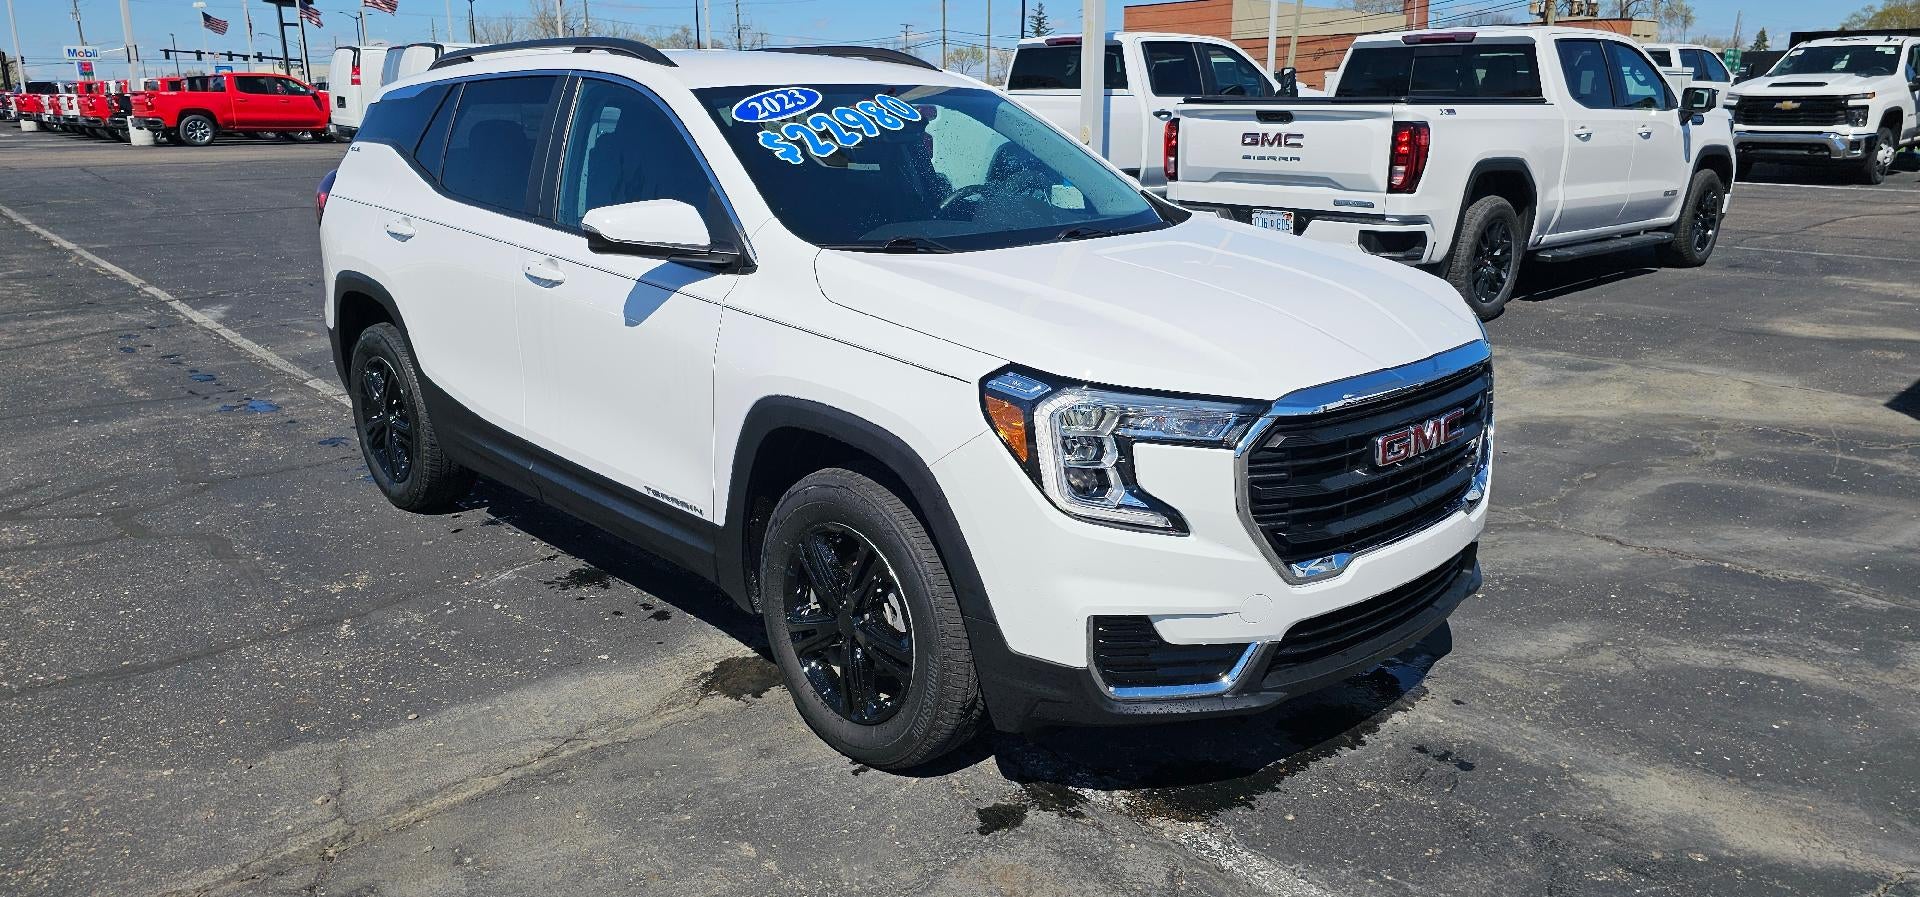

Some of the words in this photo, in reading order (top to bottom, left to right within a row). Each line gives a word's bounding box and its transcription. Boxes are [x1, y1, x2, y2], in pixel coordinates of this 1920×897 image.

[67, 48, 98, 58] Mobil
[747, 89, 807, 119] 2023
[757, 94, 921, 165] $22980
[1241, 132, 1304, 148] GMC
[1241, 154, 1301, 162] SIERRA
[1375, 407, 1465, 467] GMC
